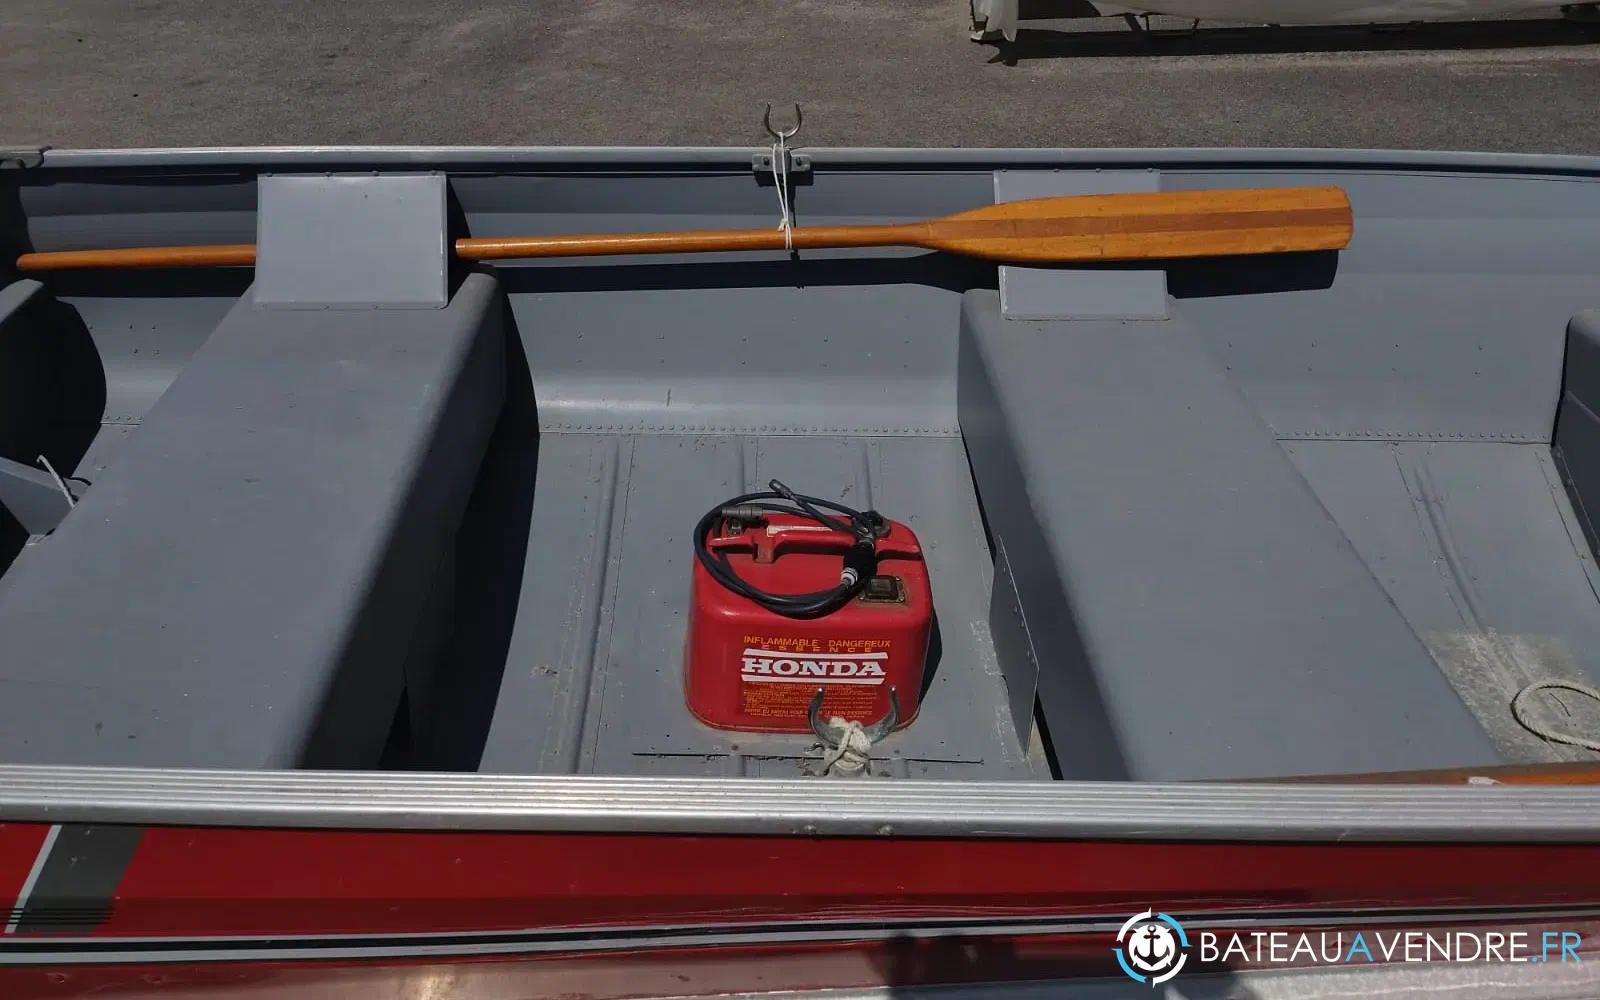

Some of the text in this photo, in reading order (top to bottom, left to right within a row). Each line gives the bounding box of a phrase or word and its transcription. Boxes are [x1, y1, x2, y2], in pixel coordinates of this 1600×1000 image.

[744, 635, 891, 648] INFLAMMABLE DANGEREUX
[741, 657, 886, 676] HONDA
